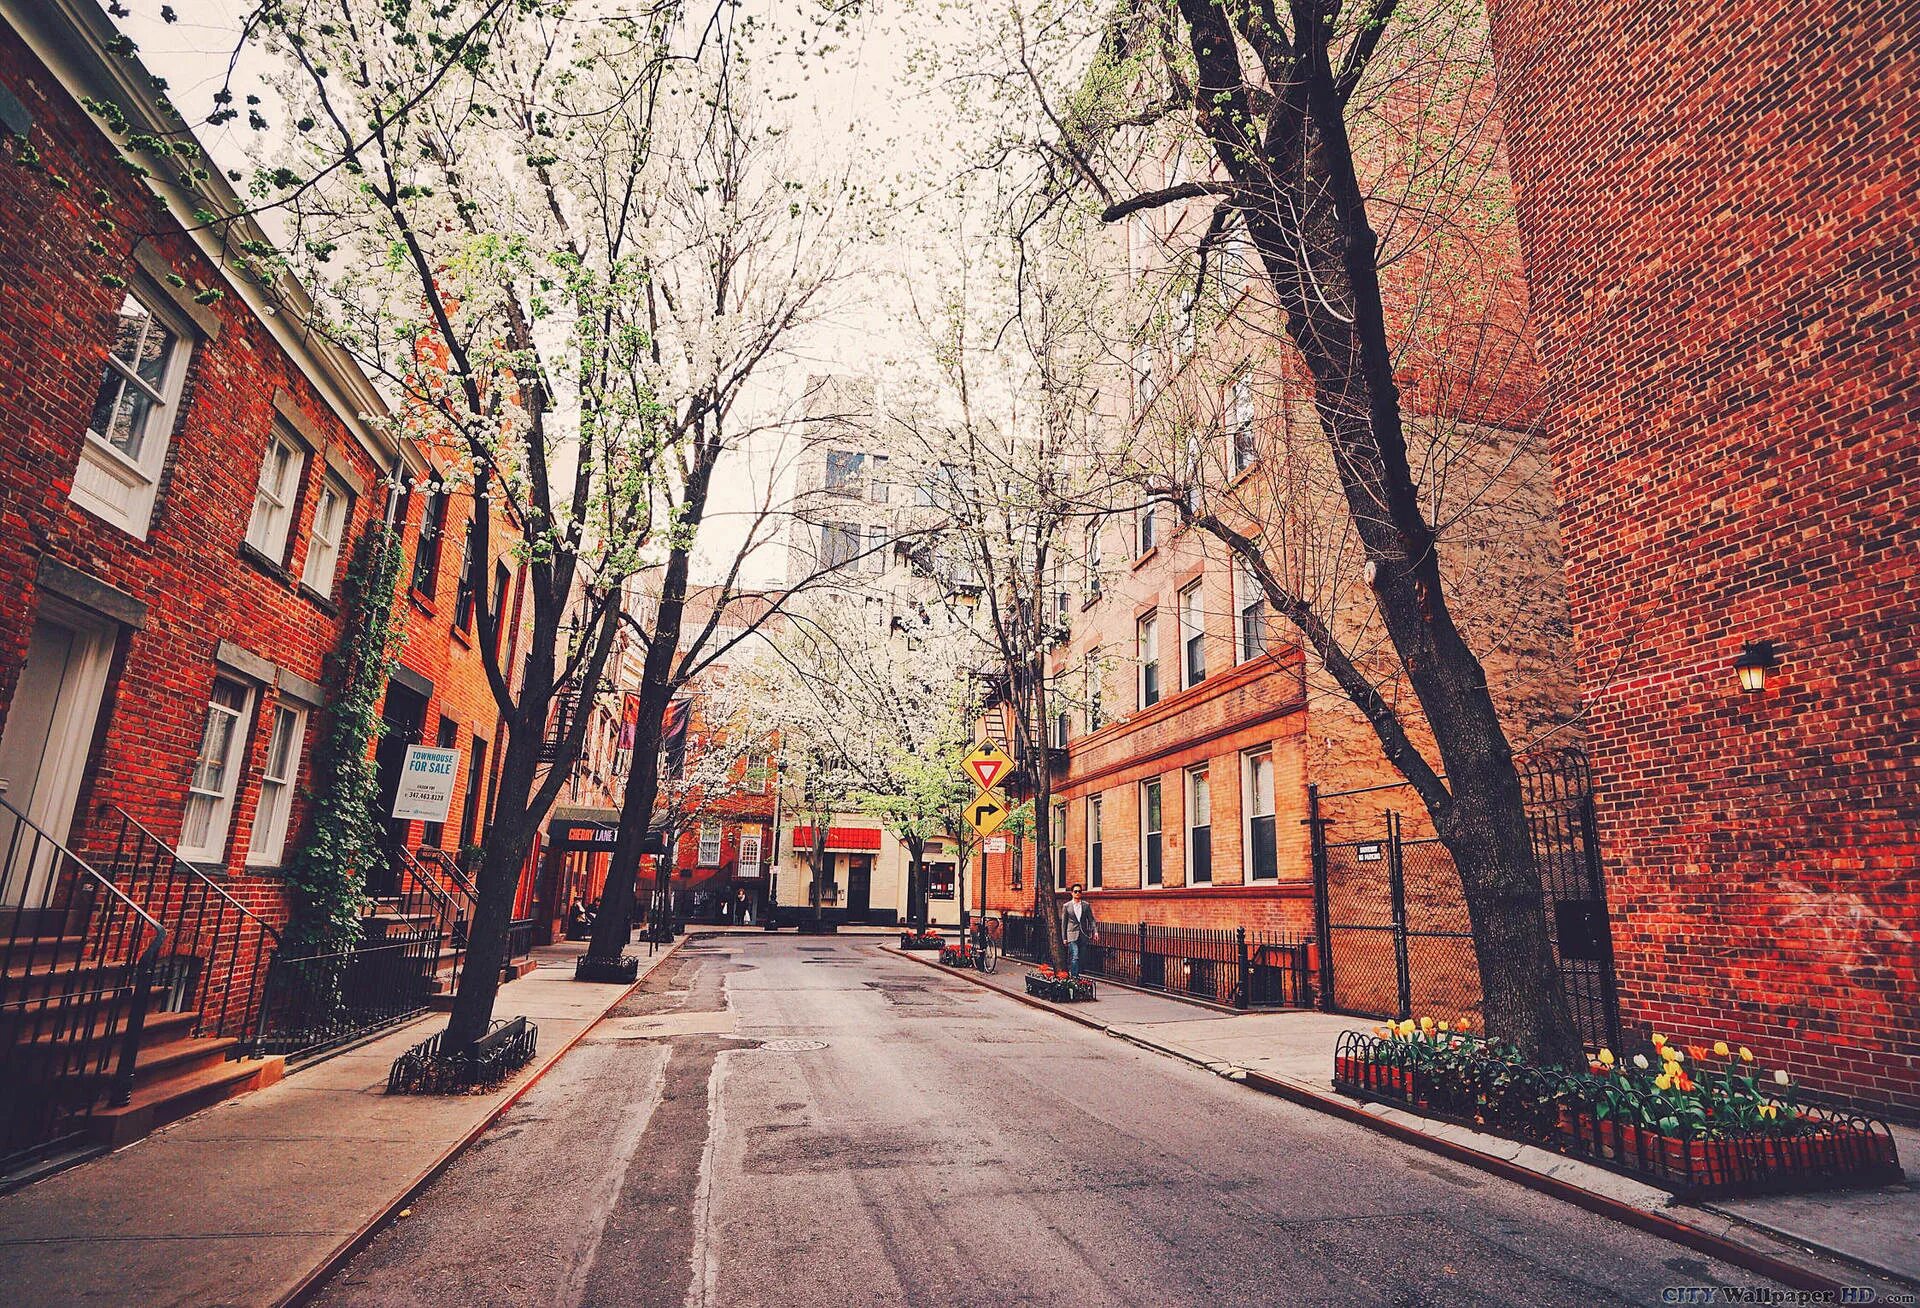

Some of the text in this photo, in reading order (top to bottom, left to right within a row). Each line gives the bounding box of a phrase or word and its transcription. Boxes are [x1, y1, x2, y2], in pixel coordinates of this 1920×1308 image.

[412, 751, 454, 763] TOWNHOUSE
[409, 761, 452, 774] FOR SALE
[595, 830, 612, 842] LANE
